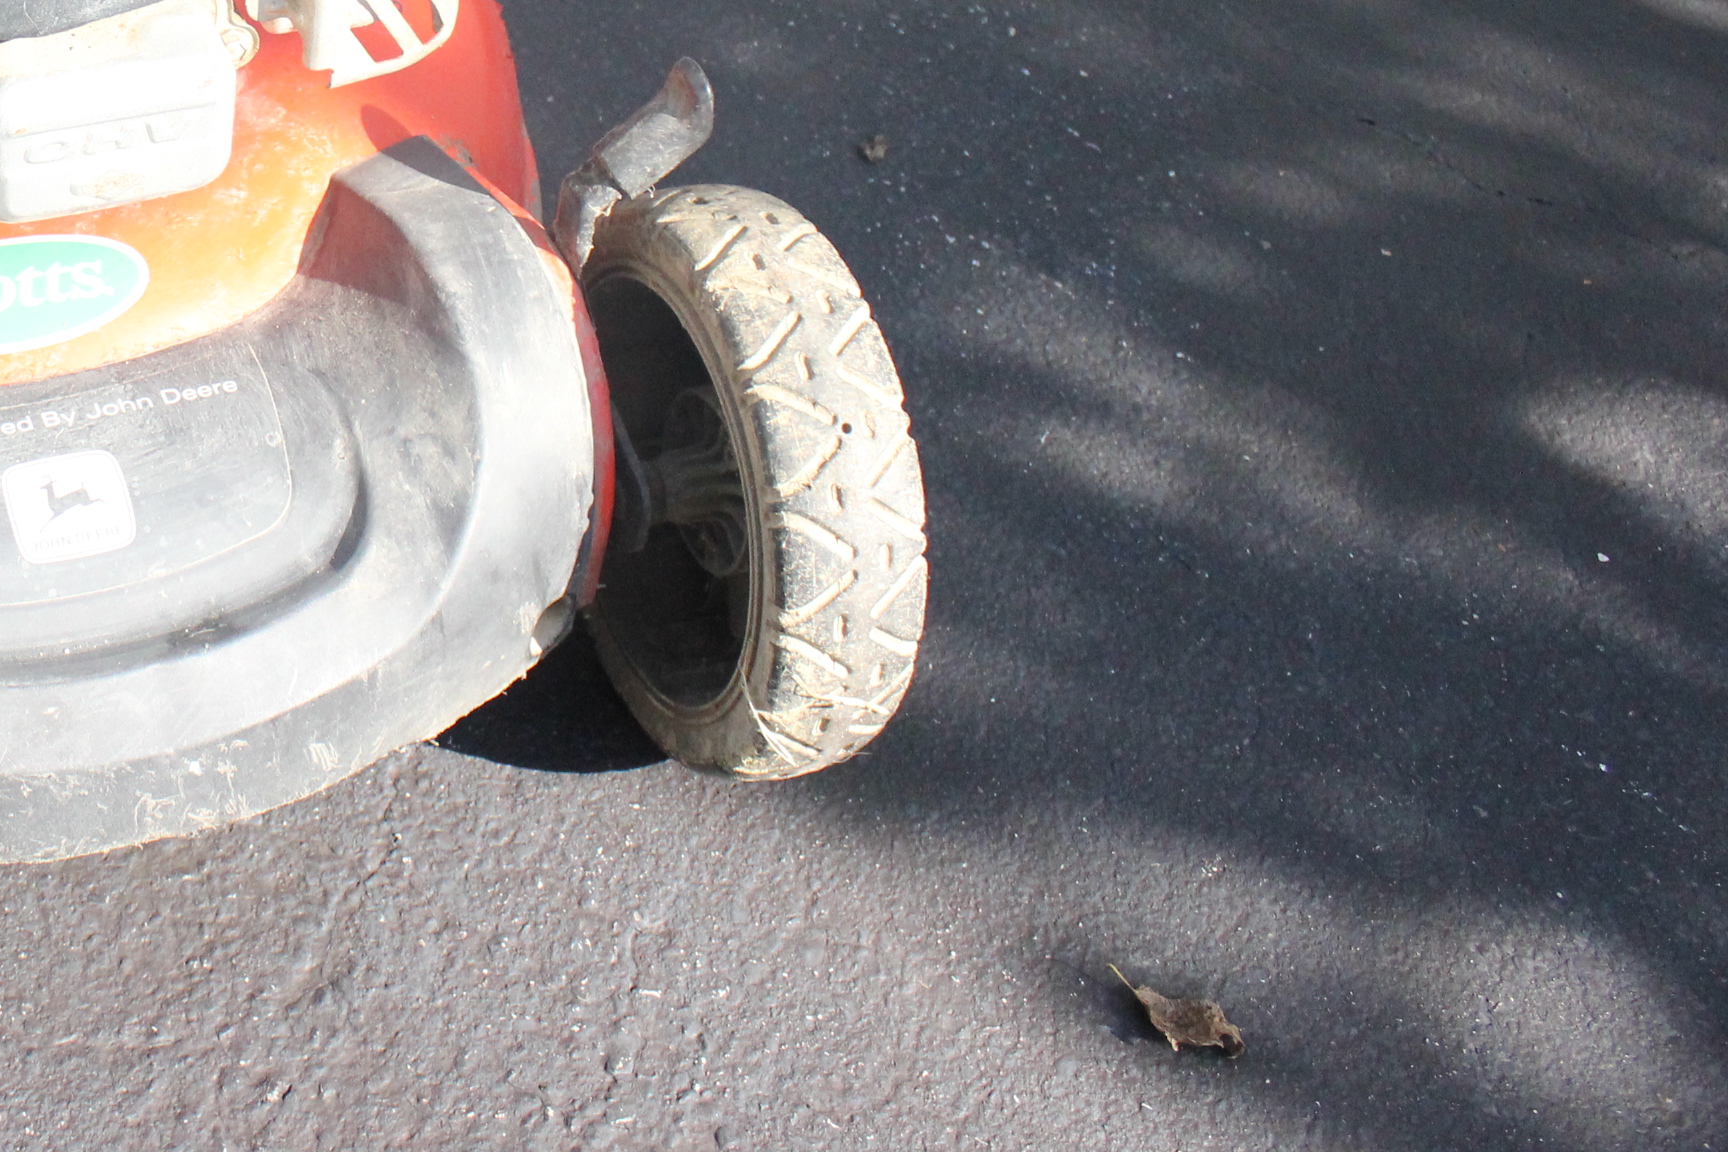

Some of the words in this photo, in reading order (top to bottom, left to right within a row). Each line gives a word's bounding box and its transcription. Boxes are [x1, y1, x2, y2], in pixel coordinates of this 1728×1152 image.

[41, 410, 76, 429] By
[86, 394, 154, 421] John
[160, 378, 239, 405] Deere
[31, 535, 72, 553] JOHN
[75, 525, 122, 542] DEERE
